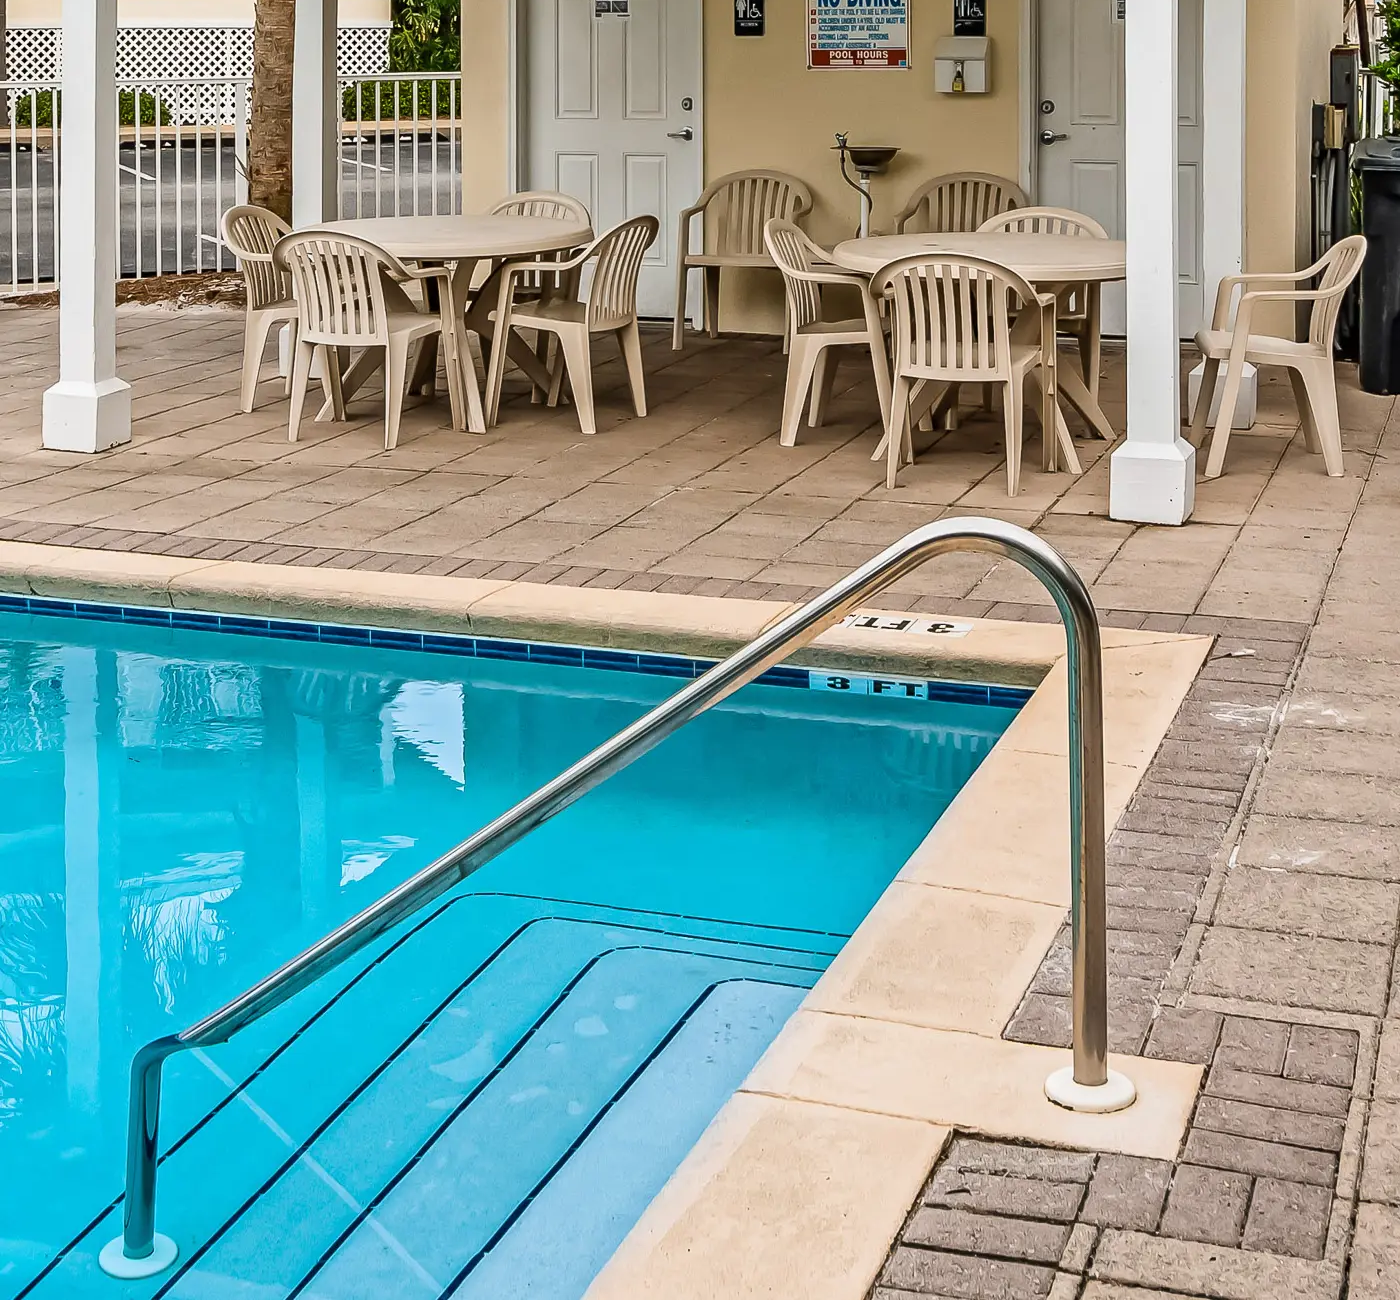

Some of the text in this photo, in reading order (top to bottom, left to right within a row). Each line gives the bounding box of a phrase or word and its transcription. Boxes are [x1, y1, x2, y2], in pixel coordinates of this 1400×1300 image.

[830, 50, 888, 58] POOL HOURS
[927, 623, 955, 633] 3
[827, 676, 851, 689] 3
